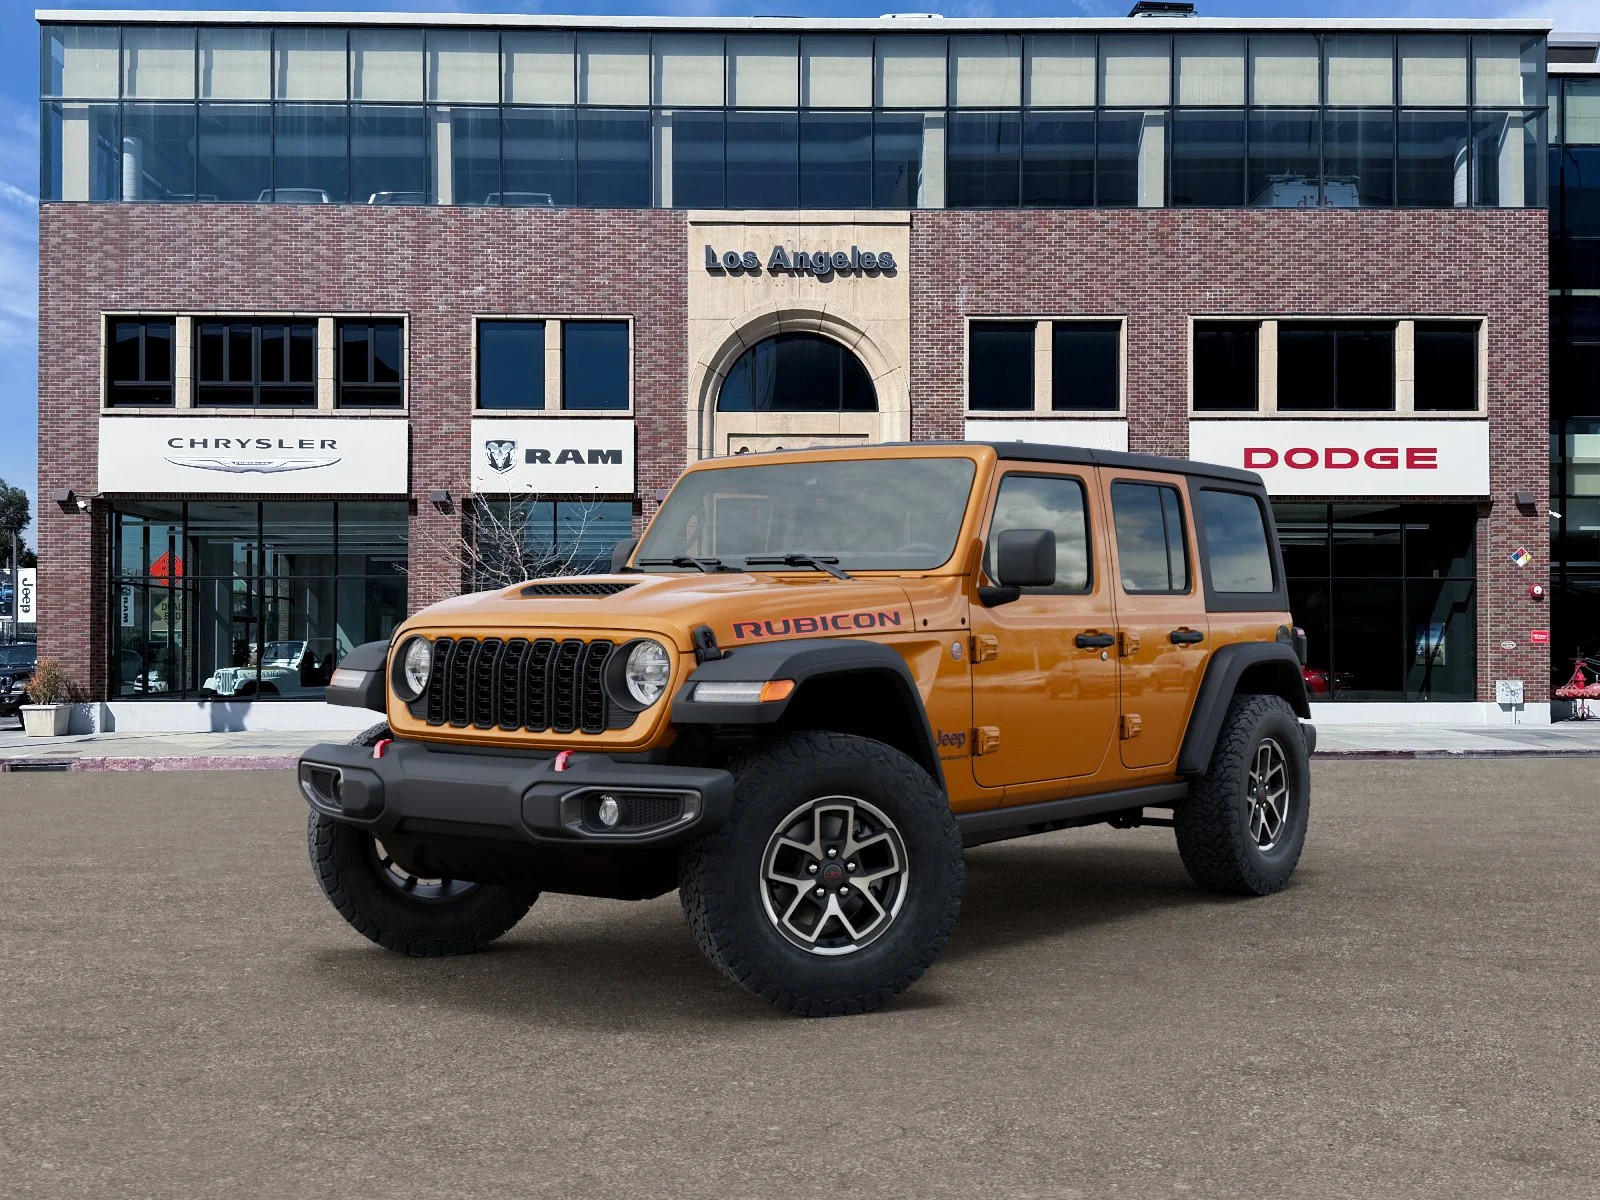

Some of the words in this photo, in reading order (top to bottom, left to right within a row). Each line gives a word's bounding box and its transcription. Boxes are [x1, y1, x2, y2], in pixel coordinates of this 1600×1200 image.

[704, 244, 759, 269] Los
[767, 245, 896, 275] Angeles
[167, 437, 338, 450] CHRYSLER
[524, 448, 623, 465] RAM
[1243, 447, 1438, 470] DODGE
[20, 578, 33, 613] Jeep
[165, 612, 181, 620] ED
[731, 610, 902, 641] RUBICON
